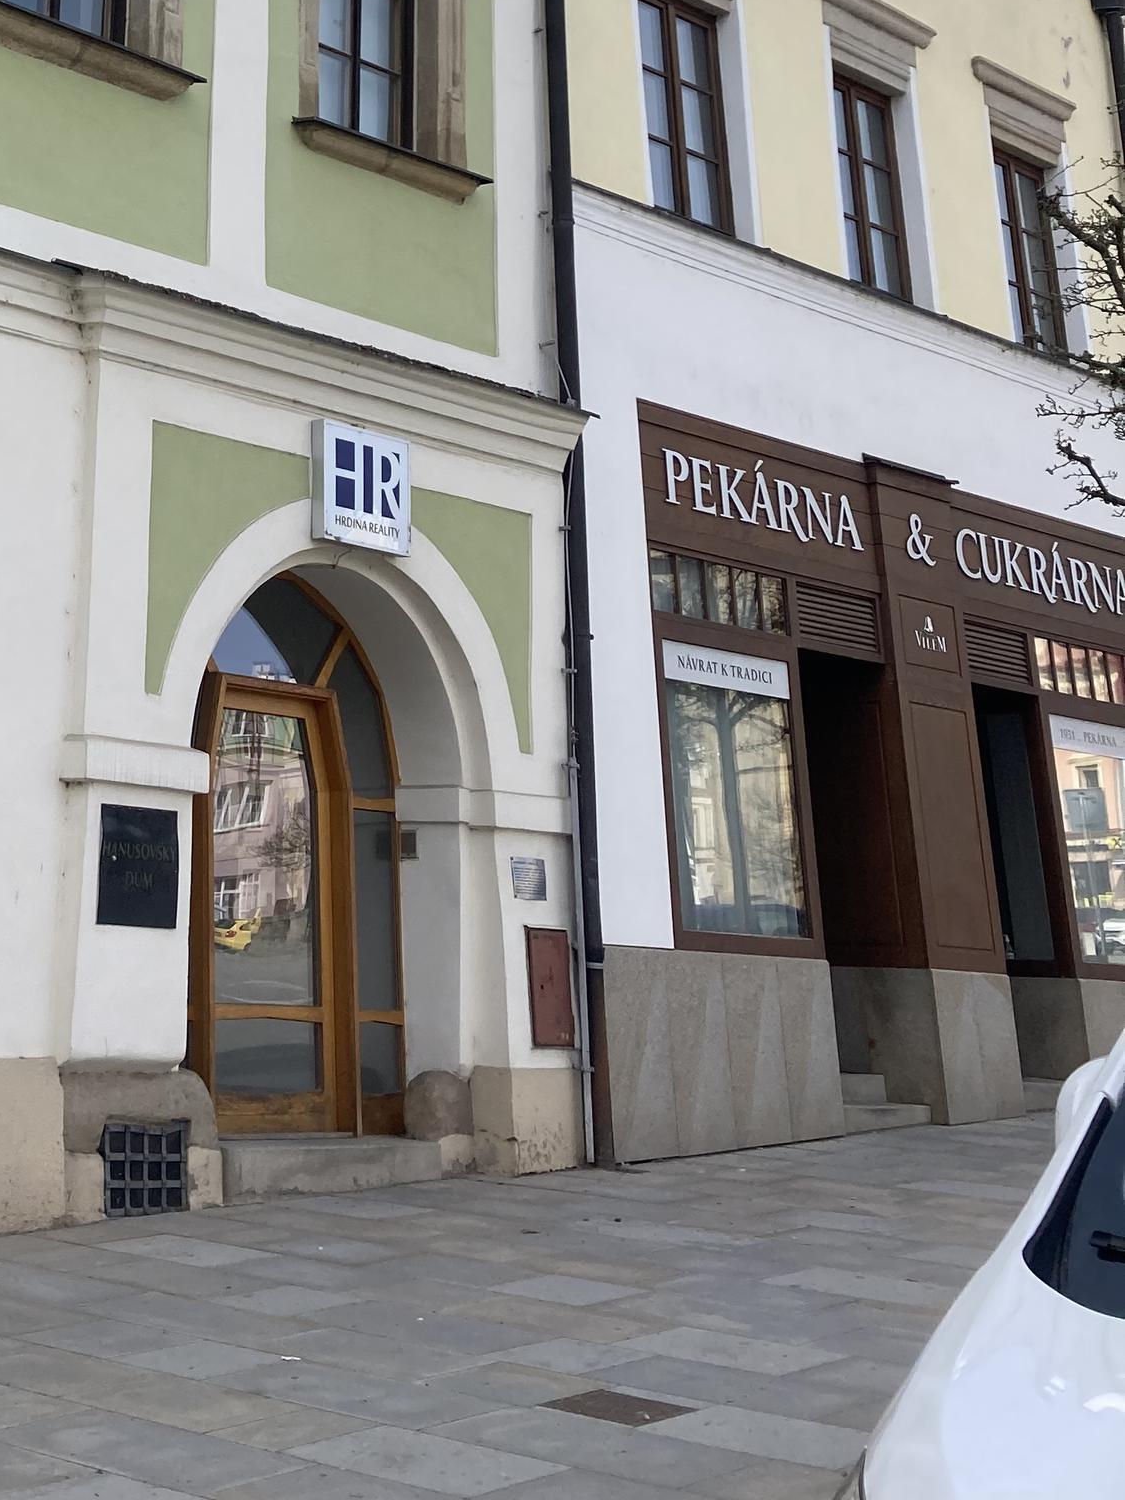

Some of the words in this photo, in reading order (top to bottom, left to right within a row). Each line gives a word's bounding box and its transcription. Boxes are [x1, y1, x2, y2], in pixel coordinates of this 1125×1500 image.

[334, 437, 401, 520] HR
[662, 447, 865, 551] PEKÁRNA
[906, 513, 937, 567] &
[335, 514, 368, 532] HRDINA
[368, 523, 401, 539] REALITY
[677, 654, 718, 675] NÁVRAT
[721, 663, 729, 677] K
[730, 664, 773, 685] TRADICI
